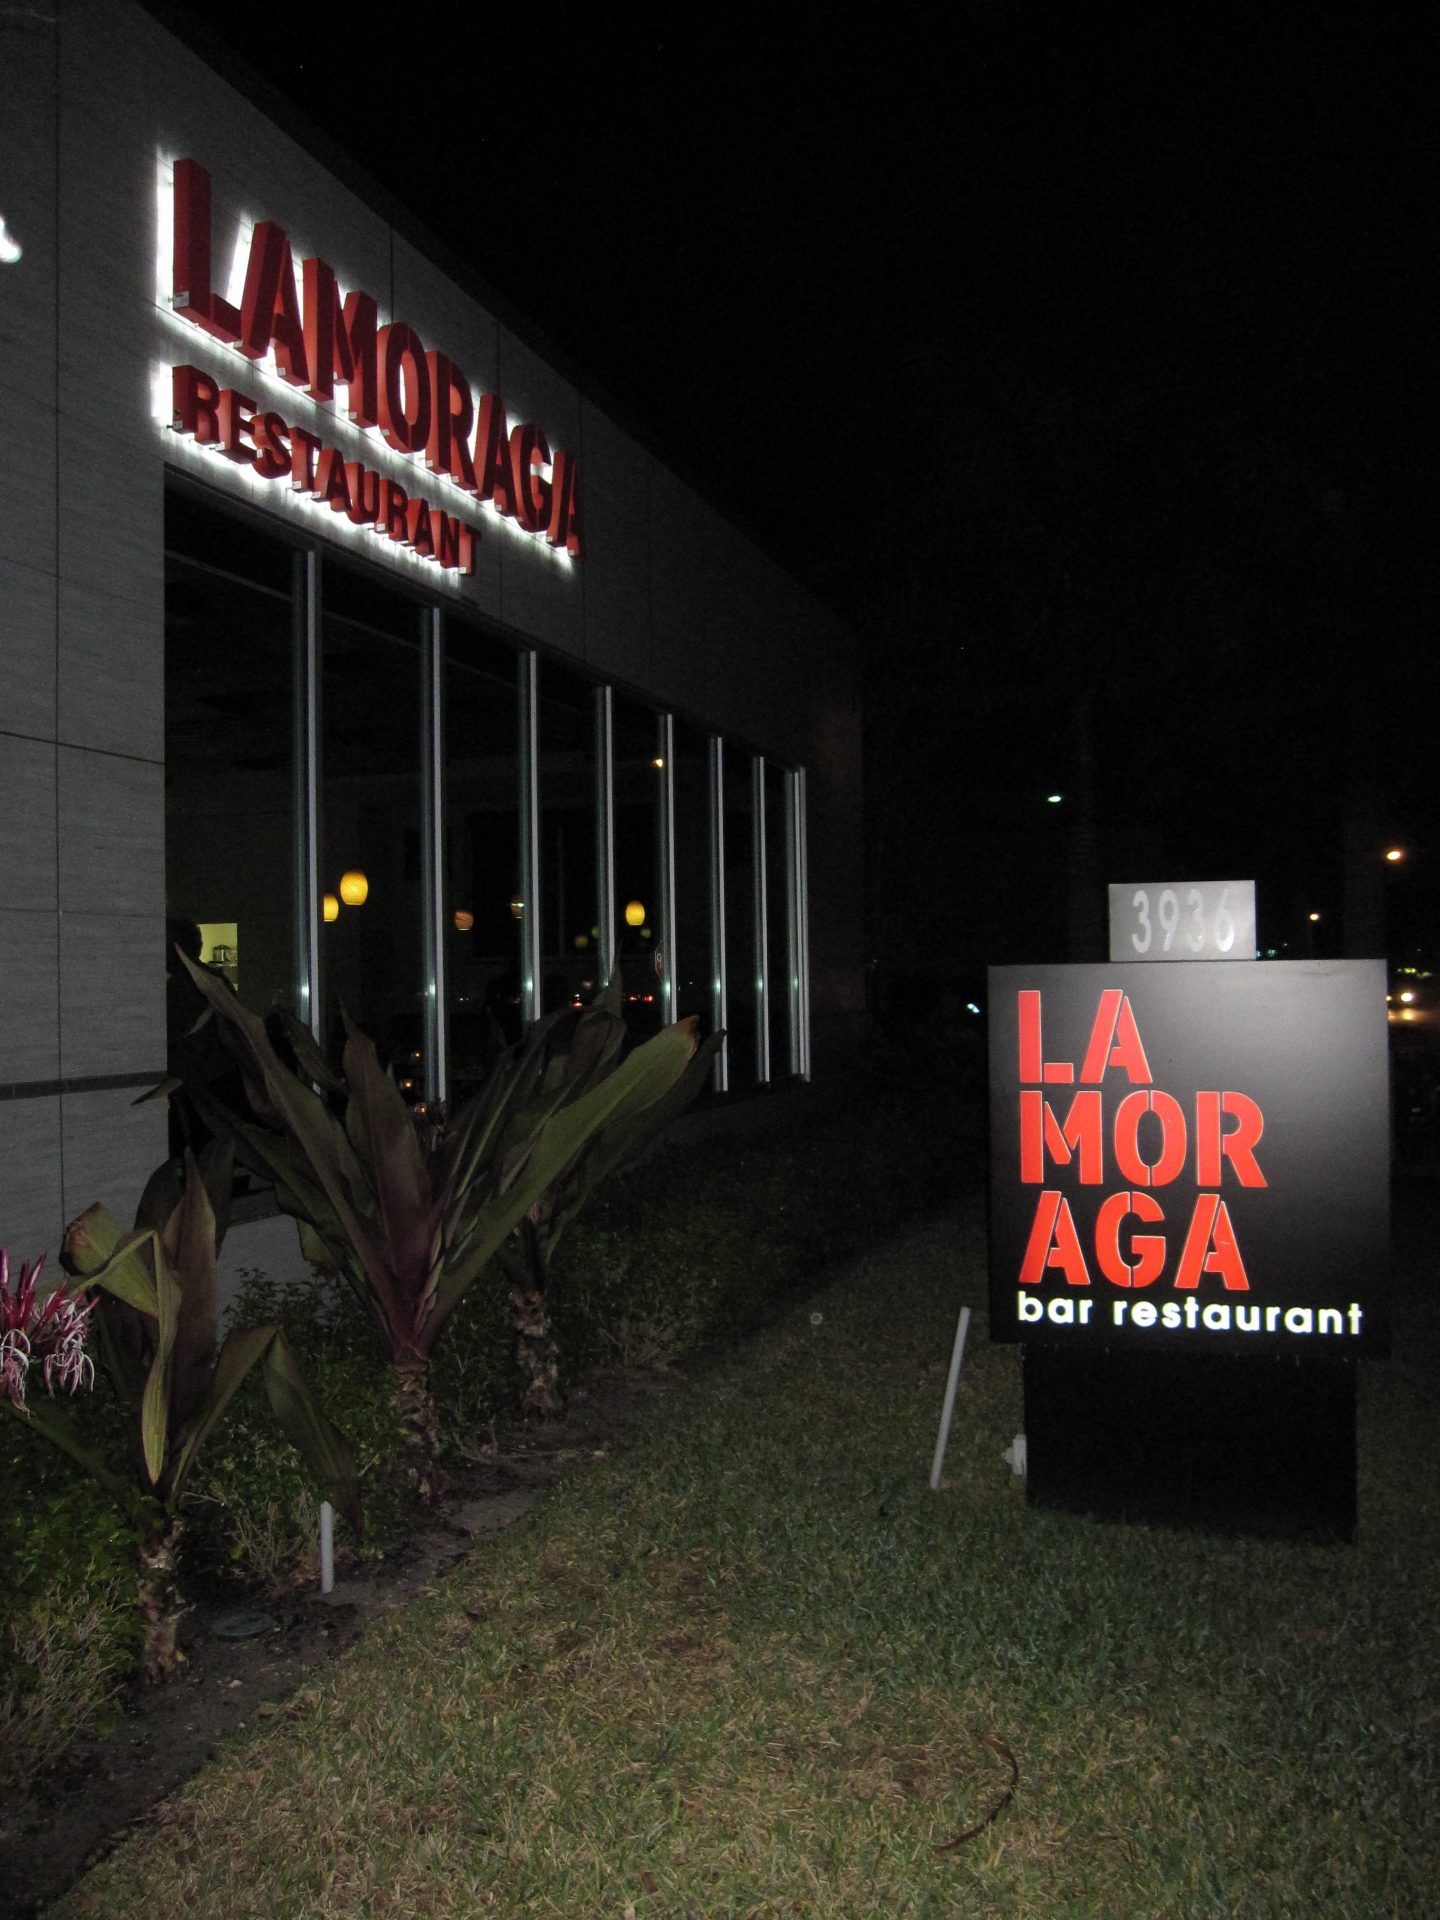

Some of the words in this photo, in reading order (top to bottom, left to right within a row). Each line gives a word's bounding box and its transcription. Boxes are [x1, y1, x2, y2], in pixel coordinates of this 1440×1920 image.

[172, 157, 585, 560] LAMORAGA
[172, 364, 481, 576] RESTAURANT
[1131, 888, 1236, 953] 3936
[1018, 988, 1153, 1084] LA
[1019, 1089, 1268, 1188] MOR
[1018, 1190, 1250, 1291] AGA
[1017, 1290, 1093, 1325] bar
[1112, 1296, 1364, 1336] restaurant
